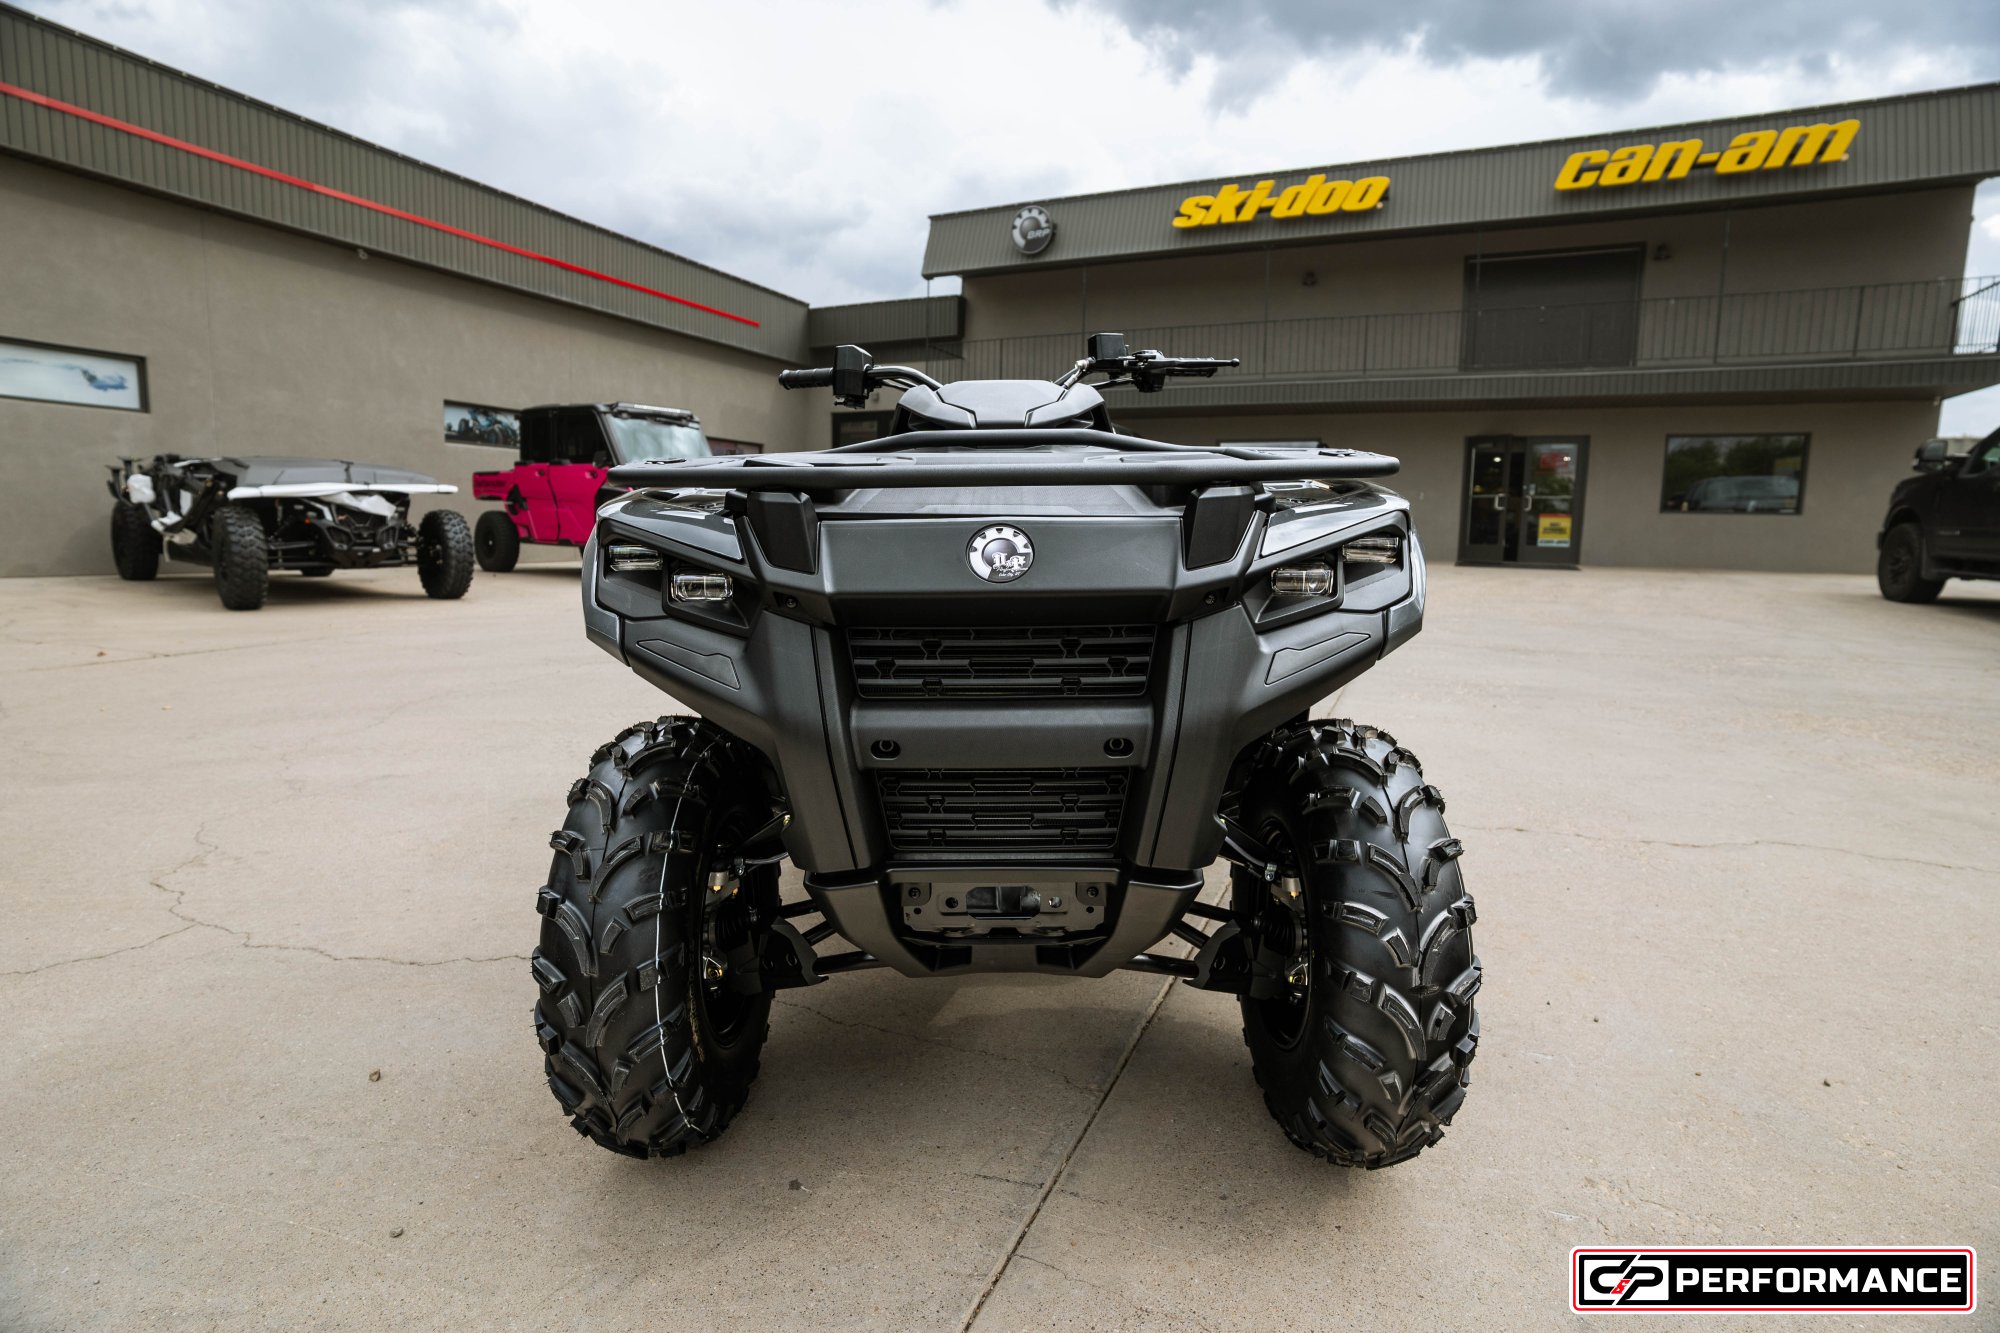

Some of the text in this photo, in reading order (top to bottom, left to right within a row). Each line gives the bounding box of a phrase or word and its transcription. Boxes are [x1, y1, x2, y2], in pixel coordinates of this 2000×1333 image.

[1554, 118, 1861, 190] can-am
[1172, 174, 1391, 229] ski-doo
[1027, 229, 1051, 240] BRP
